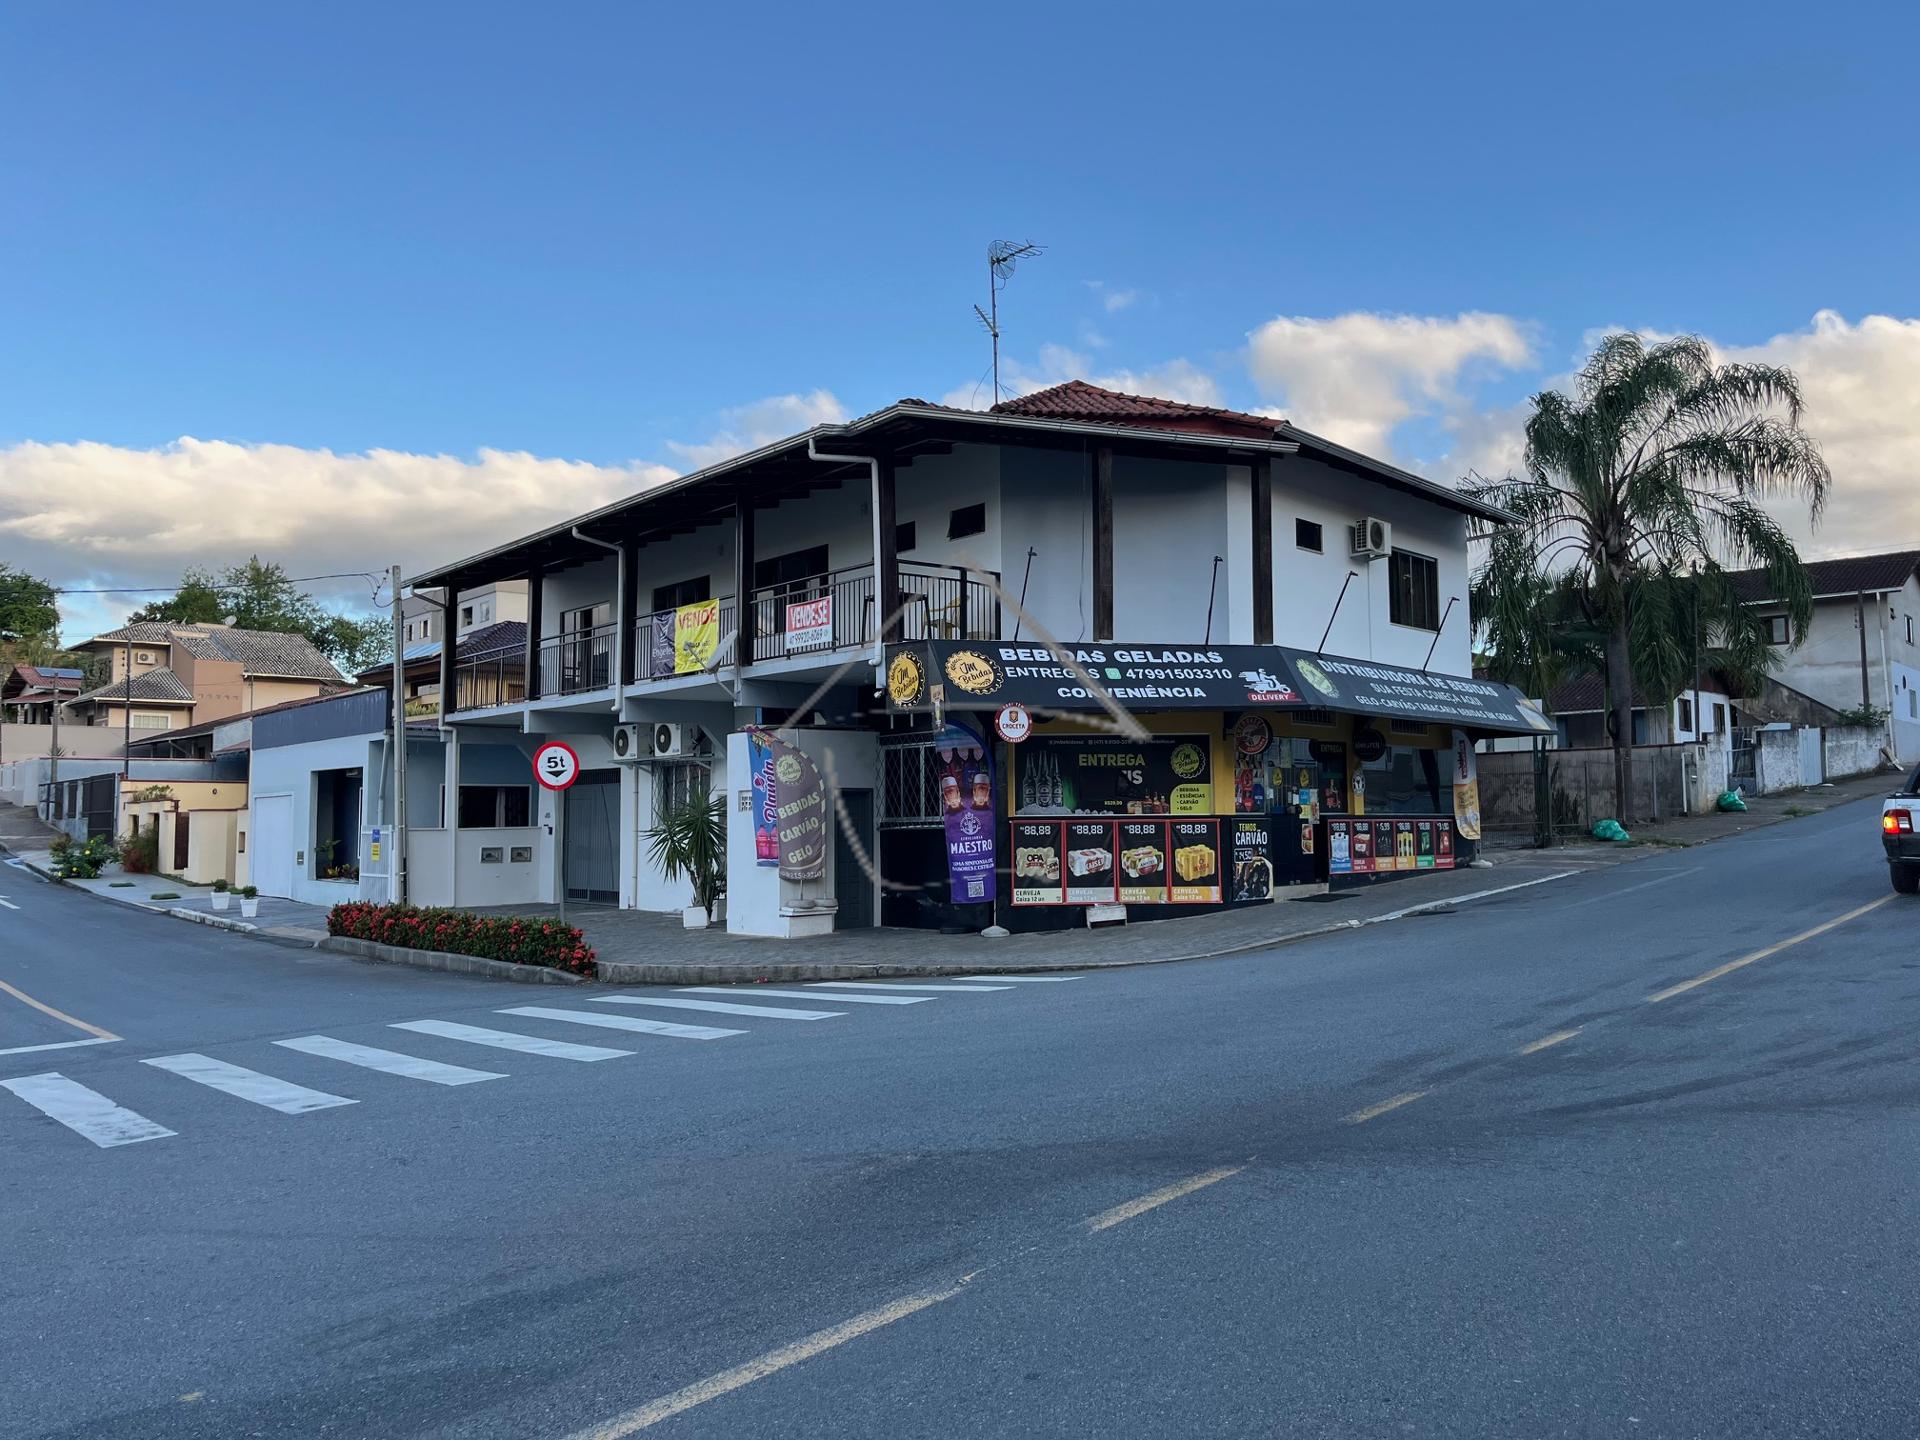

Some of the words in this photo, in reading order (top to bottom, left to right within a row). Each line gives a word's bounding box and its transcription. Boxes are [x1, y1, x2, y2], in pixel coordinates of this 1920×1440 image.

[679, 607, 717, 630] VENDE
[790, 600, 828, 630] VENDE-SE
[999, 648, 1107, 663] BEBIDAS
[1113, 650, 1224, 664] GELADAS
[959, 669, 992, 684] Bebidas
[1126, 668, 1232, 680] 47991503310
[1317, 659, 1430, 687] DISTRIBUIDORA
[1426, 676, 1449, 690] DE
[1446, 679, 1499, 697] BEBIDAS
[1251, 693, 1290, 702] DELIVERY
[1391, 685, 1424, 698] FESTA
[547, 756, 565, 769] 5t
[1078, 754, 1146, 767] ENTREGA
[778, 791, 821, 820] BEBIDAS
[779, 816, 819, 844] CARVÃO
[1239, 823, 1257, 832] TEMOS
[1235, 829, 1268, 845] CARVÃO
[788, 844, 813, 864] GELO
[950, 839, 993, 854] MAESTRO
[1026, 854, 1044, 863] OPA
